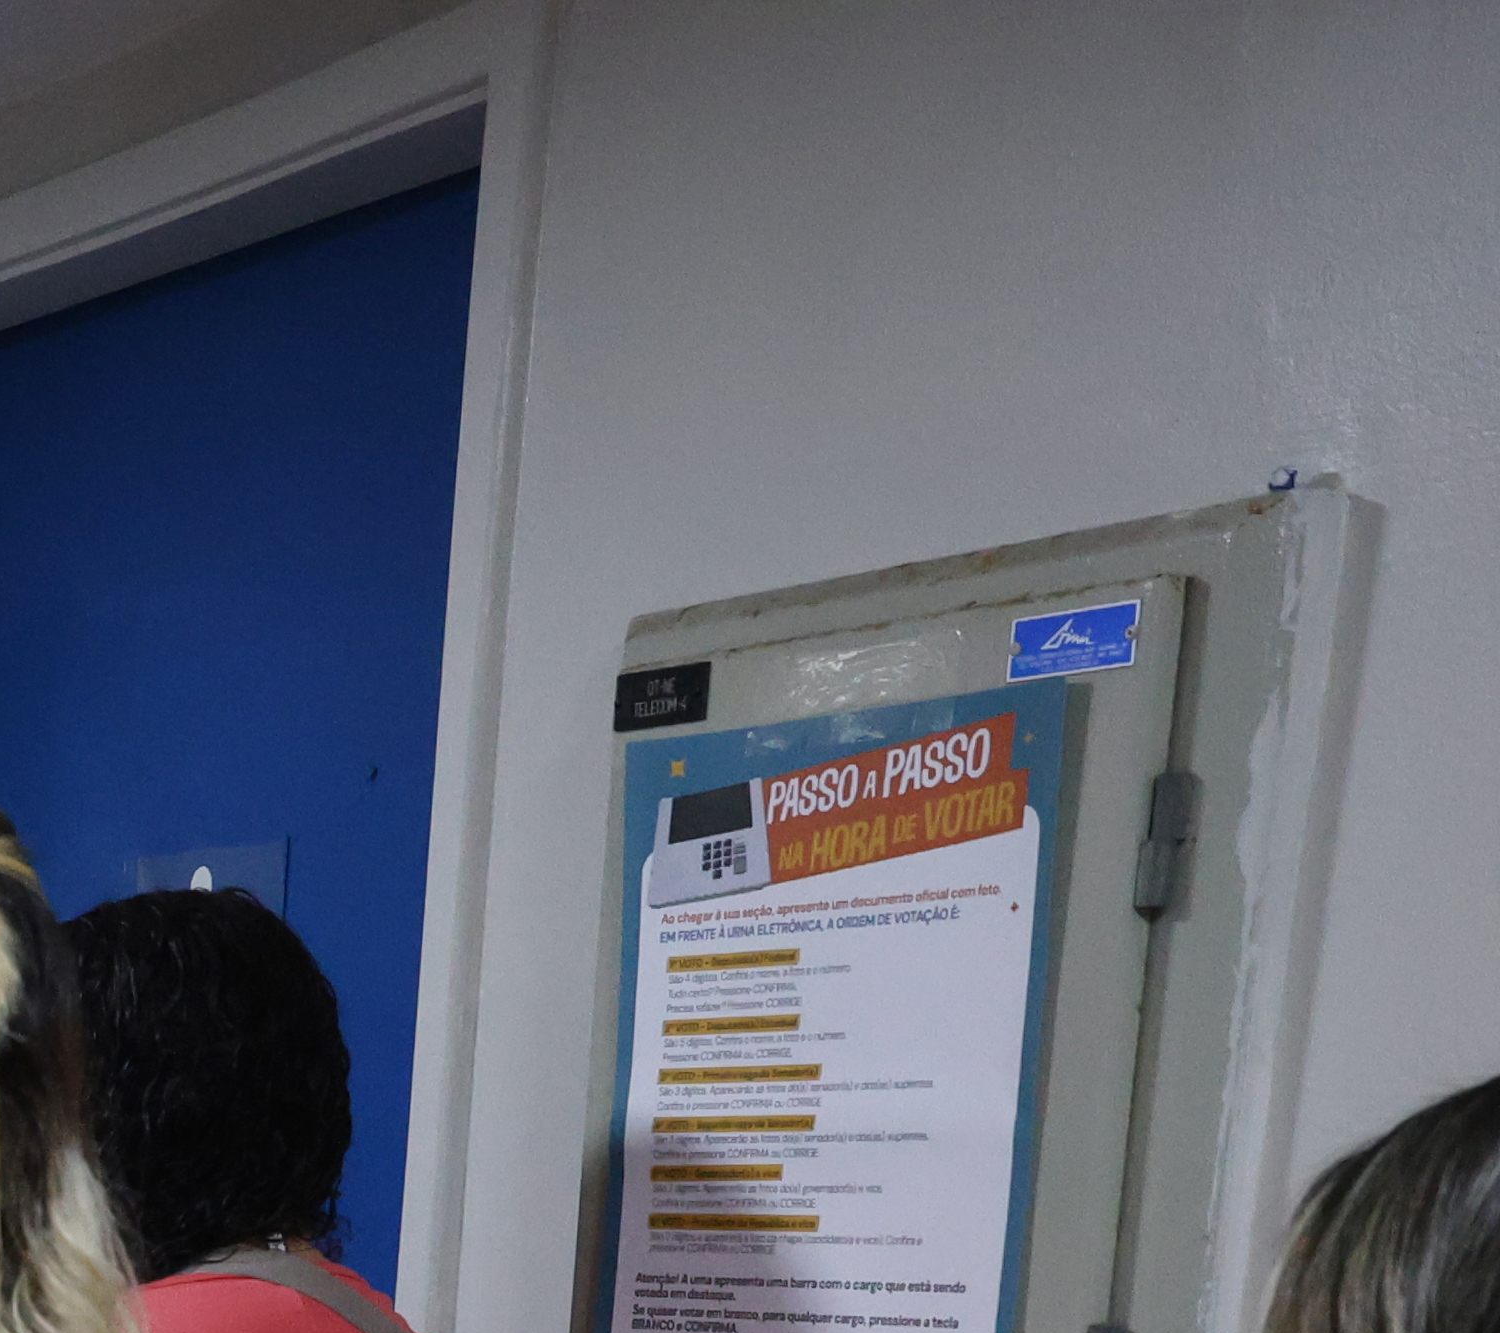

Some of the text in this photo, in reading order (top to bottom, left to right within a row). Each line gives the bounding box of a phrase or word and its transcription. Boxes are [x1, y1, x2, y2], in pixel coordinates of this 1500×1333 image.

[766, 727, 991, 825] PASSO A PASSO
[779, 781, 1017, 872] NA HORA DE VOTAR
[661, 913, 675, 925] Ao
[677, 911, 713, 926] chegar
[724, 910, 741, 919] sua
[776, 901, 830, 916] apresente
[832, 900, 848, 910] um
[850, 893, 914, 909] documento
[915, 888, 949, 902] oficial
[950, 888, 976, 899] com
[660, 930, 677, 944] EM
[678, 928, 716, 942] FRENTE
[727, 926, 755, 939] URNA
[827, 918, 834, 930] A
[836, 914, 875, 929] ORDEM
[877, 913, 891, 926] DE
[894, 905, 949, 926] VOTAÇÃO
[670, 1290, 686, 1299] em
[681, 1274, 688, 1285] A
[714, 1276, 765, 1289] apresenta
[819, 1280, 842, 1290] com
[844, 1281, 851, 1290] o
[853, 1281, 884, 1295] cargo
[885, 1281, 907, 1294] que
[907, 1280, 931, 1293] está
[933, 1281, 967, 1294] sendo
[631, 1318, 675, 1331] BRANCO
[632, 1304, 645, 1316] Se
[706, 1309, 722, 1318] em
[762, 1311, 786, 1322] para
[788, 1311, 834, 1325] qualquer
[869, 1315, 922, 1328] pressione
[923, 1319, 930, 1327] a
[932, 1316, 959, 1329] tecla
